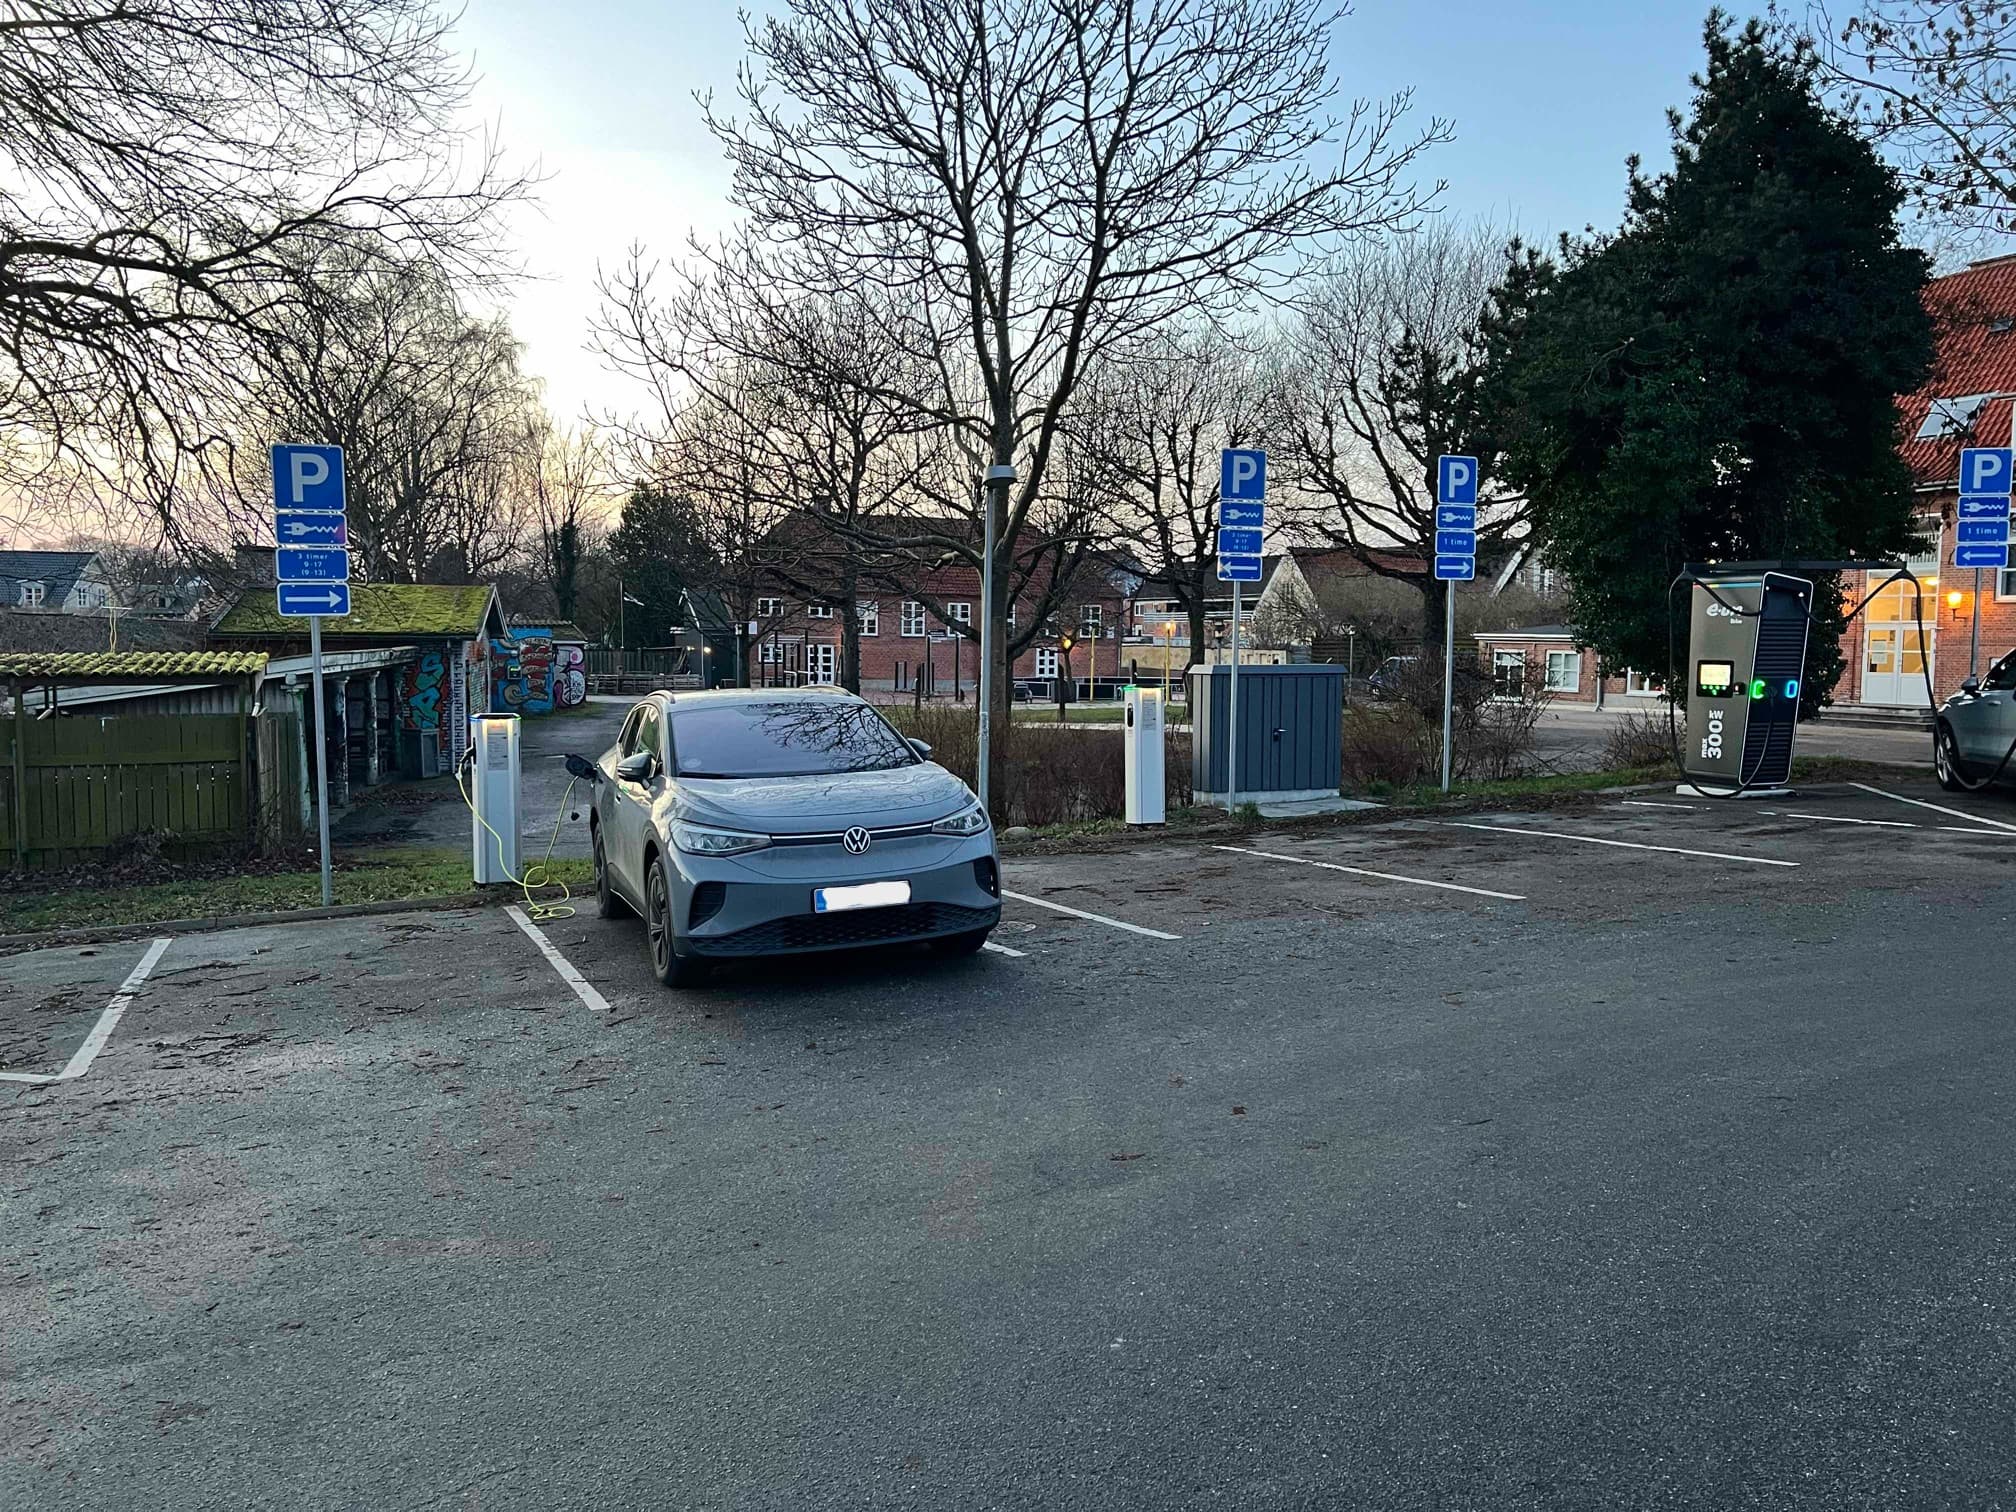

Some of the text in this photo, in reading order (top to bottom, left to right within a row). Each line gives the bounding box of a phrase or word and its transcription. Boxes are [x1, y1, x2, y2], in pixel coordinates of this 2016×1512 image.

[290, 452, 329, 503] P
[1232, 455, 1257, 494] P
[1448, 462, 1470, 498] P
[1973, 454, 2003, 489] P
[1450, 538, 1468, 546] time
[1976, 527, 1998, 535] time
[1709, 709, 1724, 720] kW
[1707, 720, 1723, 759] 300
